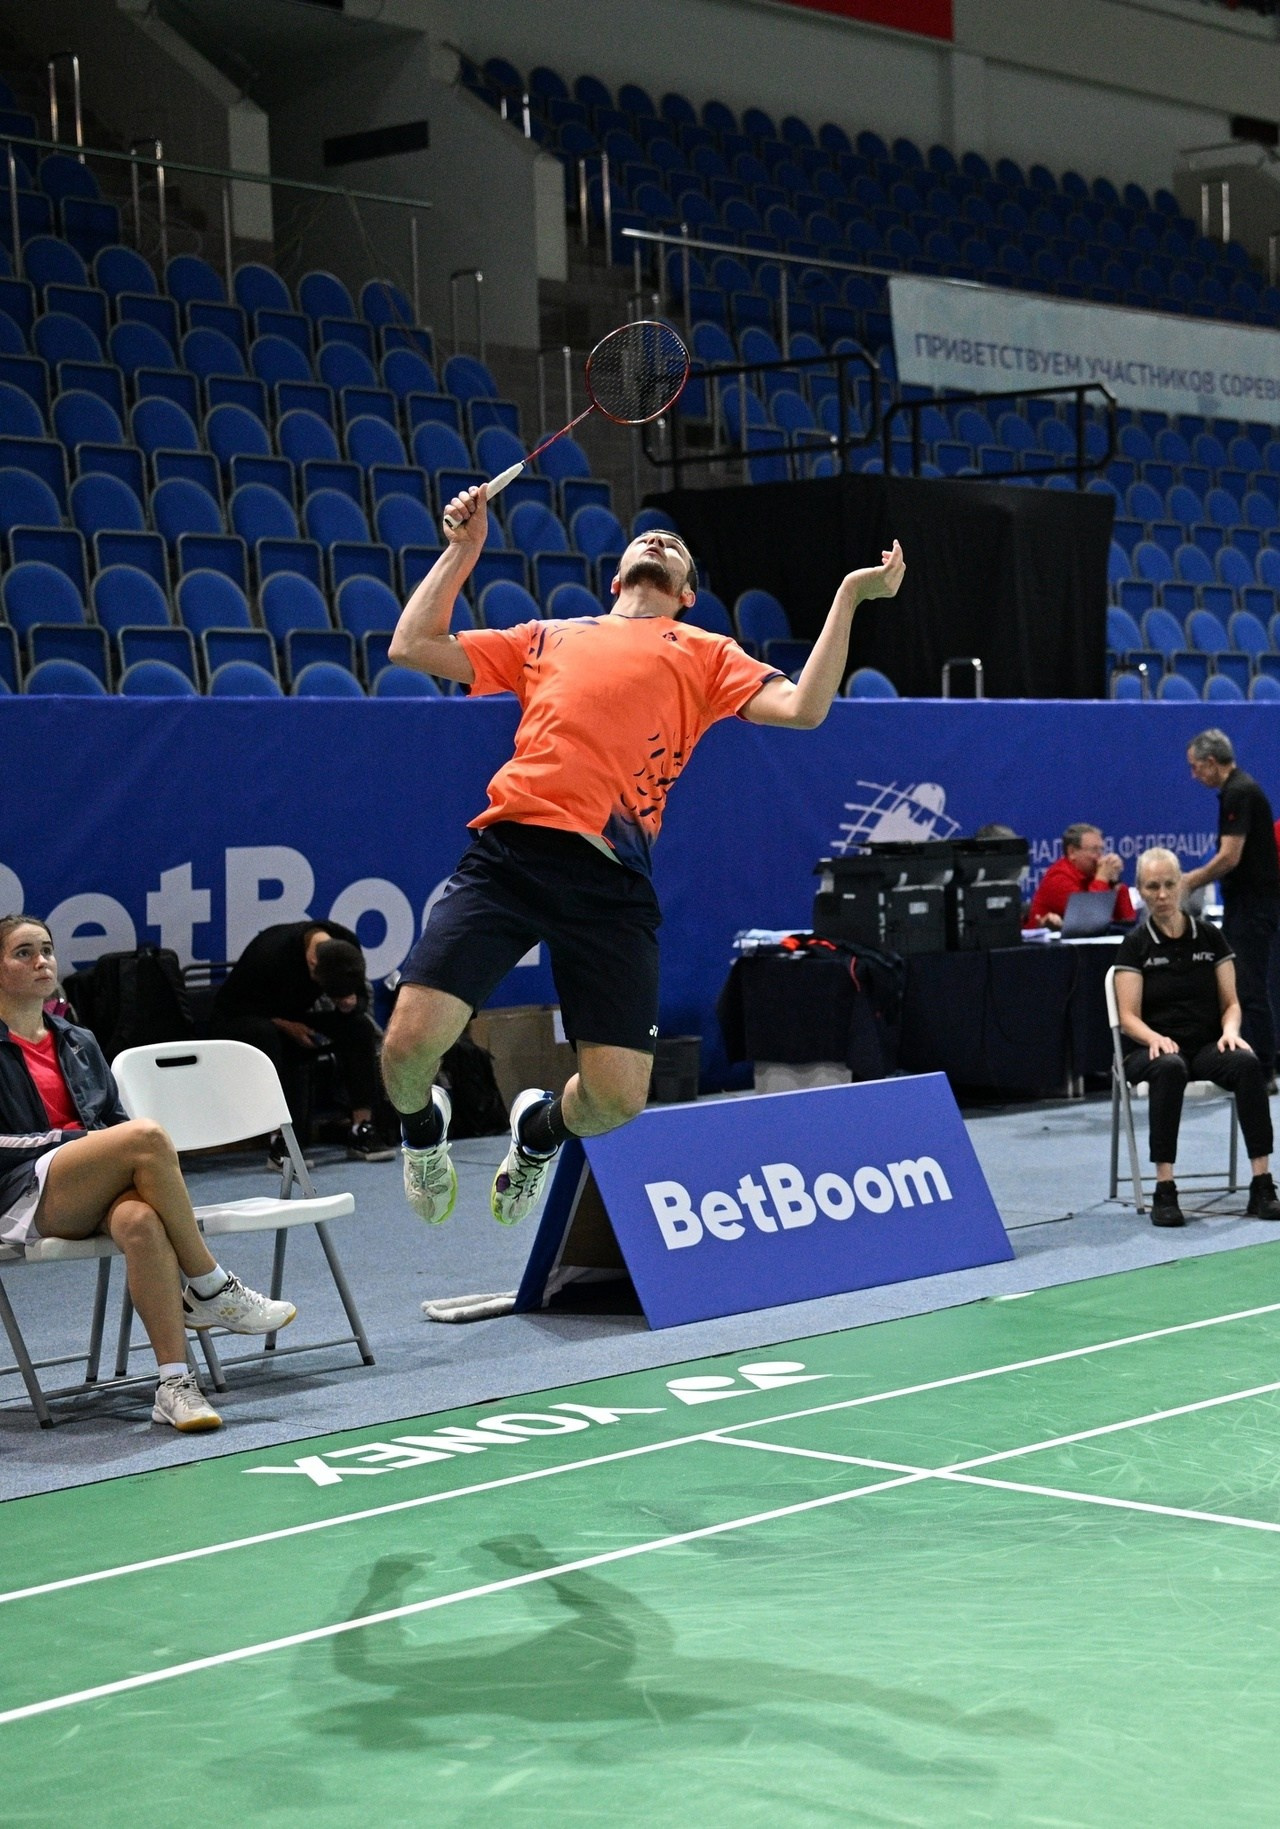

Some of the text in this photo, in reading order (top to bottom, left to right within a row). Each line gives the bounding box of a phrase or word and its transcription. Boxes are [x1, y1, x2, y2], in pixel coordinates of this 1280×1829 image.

[914, 333, 1083, 378] ПРИВЕТСТВУЕМ
[1085, 356, 1216, 395] УЧАСТНИКОВ
[644, 1156, 953, 1251] BetBoom
[241, 1402, 668, 1487] YONEX
